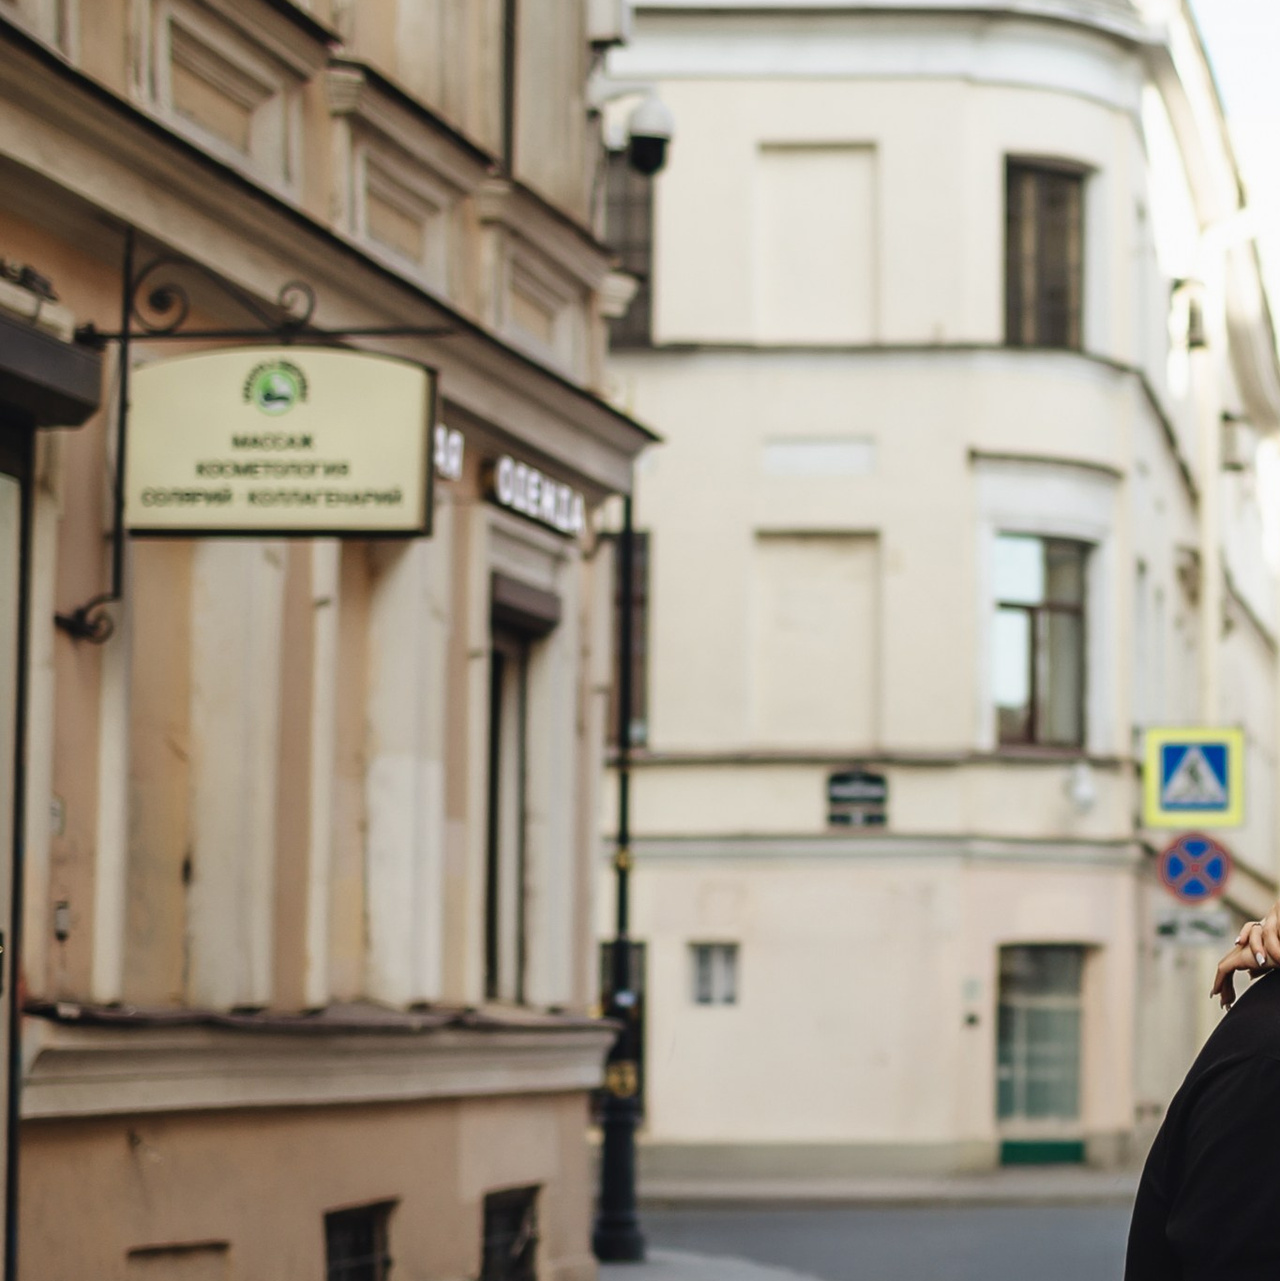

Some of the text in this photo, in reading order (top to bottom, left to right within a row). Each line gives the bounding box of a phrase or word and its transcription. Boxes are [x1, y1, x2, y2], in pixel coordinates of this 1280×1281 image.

[231, 431, 313, 450] МАССАЖ
[195, 461, 348, 478] КОСМЕТОЛОГИЯ
[141, 486, 233, 506] СОЛЯРИЙ
[494, 454, 586, 534] ОДЕЖДА
